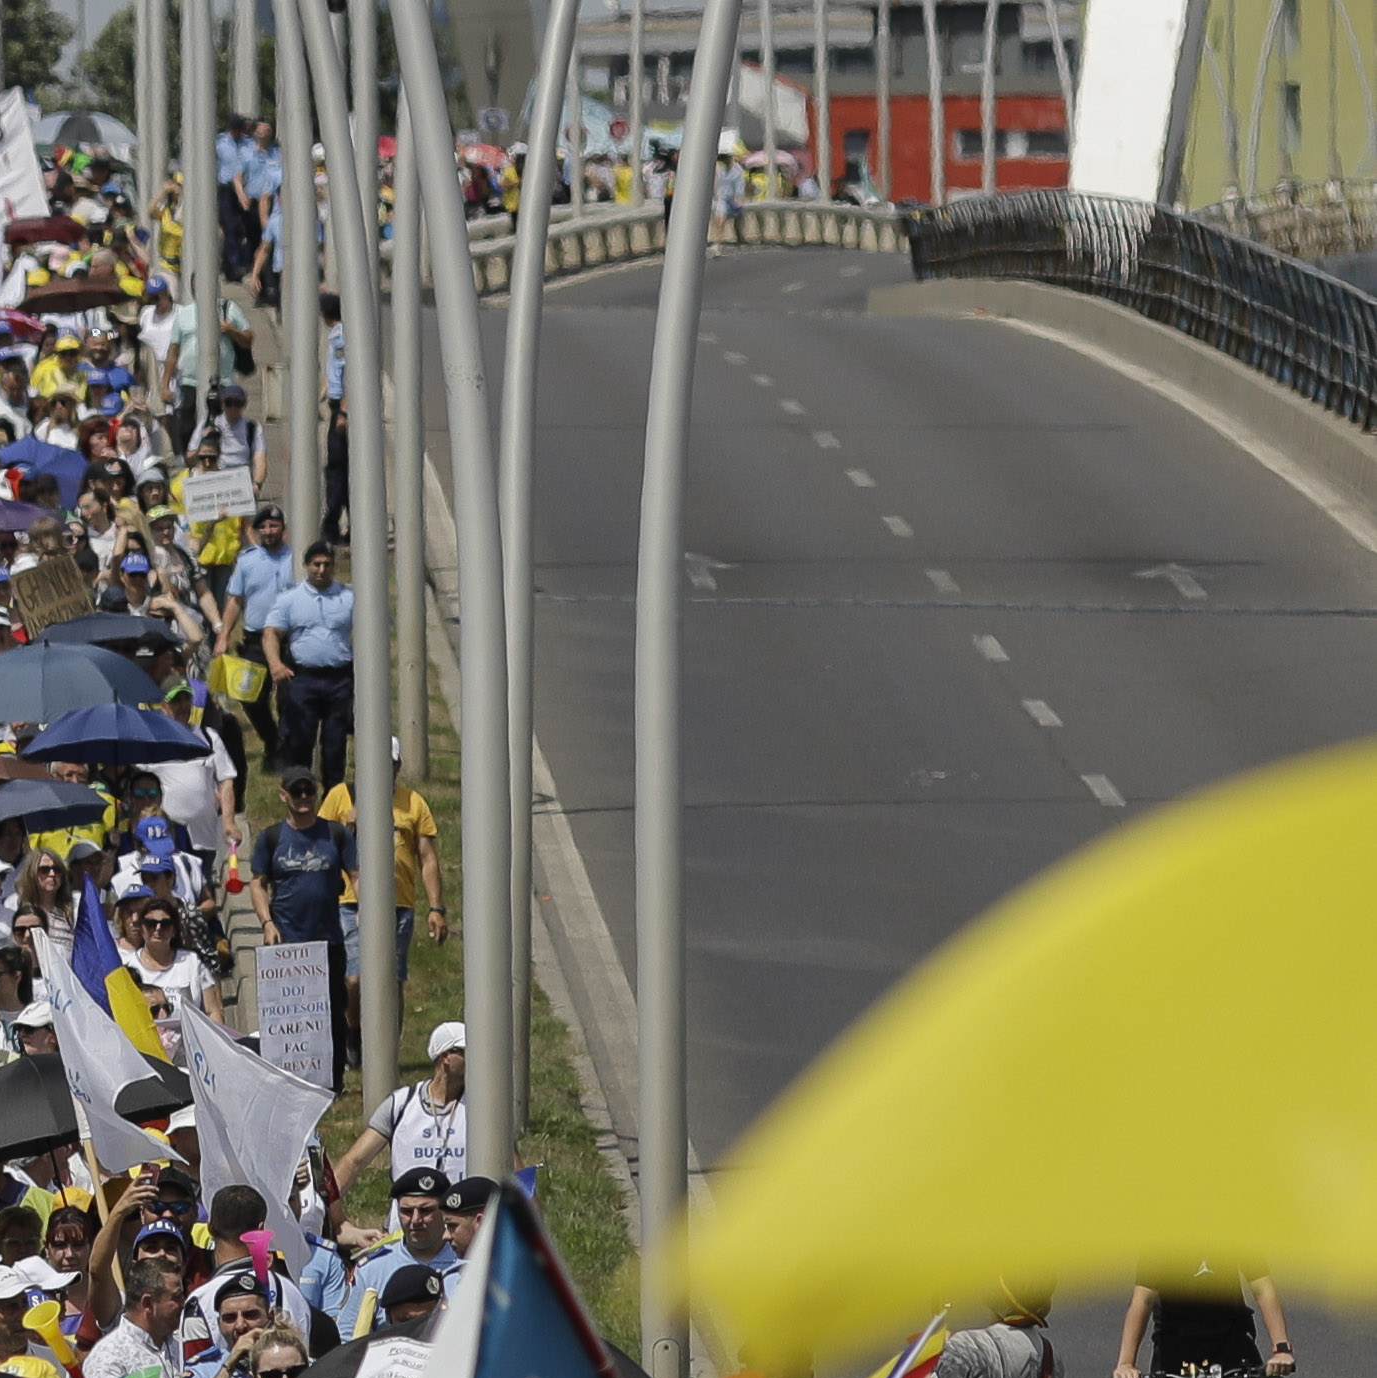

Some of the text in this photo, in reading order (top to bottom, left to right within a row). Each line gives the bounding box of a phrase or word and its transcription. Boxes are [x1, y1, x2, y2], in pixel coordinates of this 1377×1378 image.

[268, 1021, 303, 1036] CARE
[285, 1042, 309, 1053] FAC
[277, 1057, 321, 1073] REVĂ!
